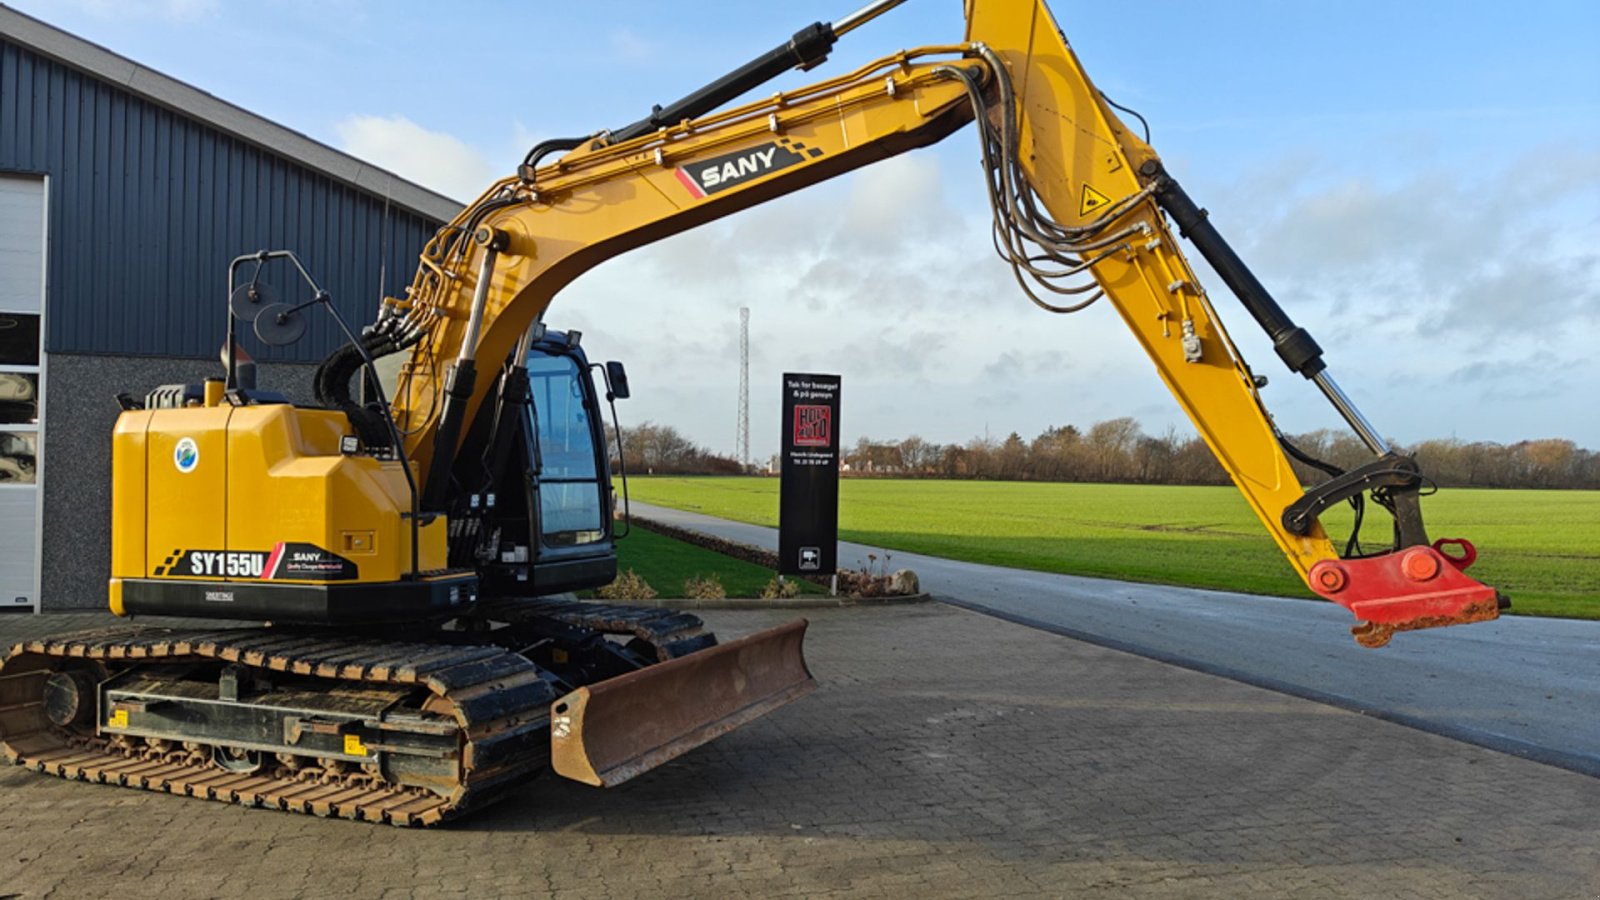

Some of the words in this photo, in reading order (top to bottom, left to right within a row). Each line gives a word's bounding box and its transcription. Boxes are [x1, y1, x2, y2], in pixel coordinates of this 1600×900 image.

[701, 147, 776, 188] SANY
[190, 551, 263, 577] SY155U
[293, 553, 320, 561] SANY
